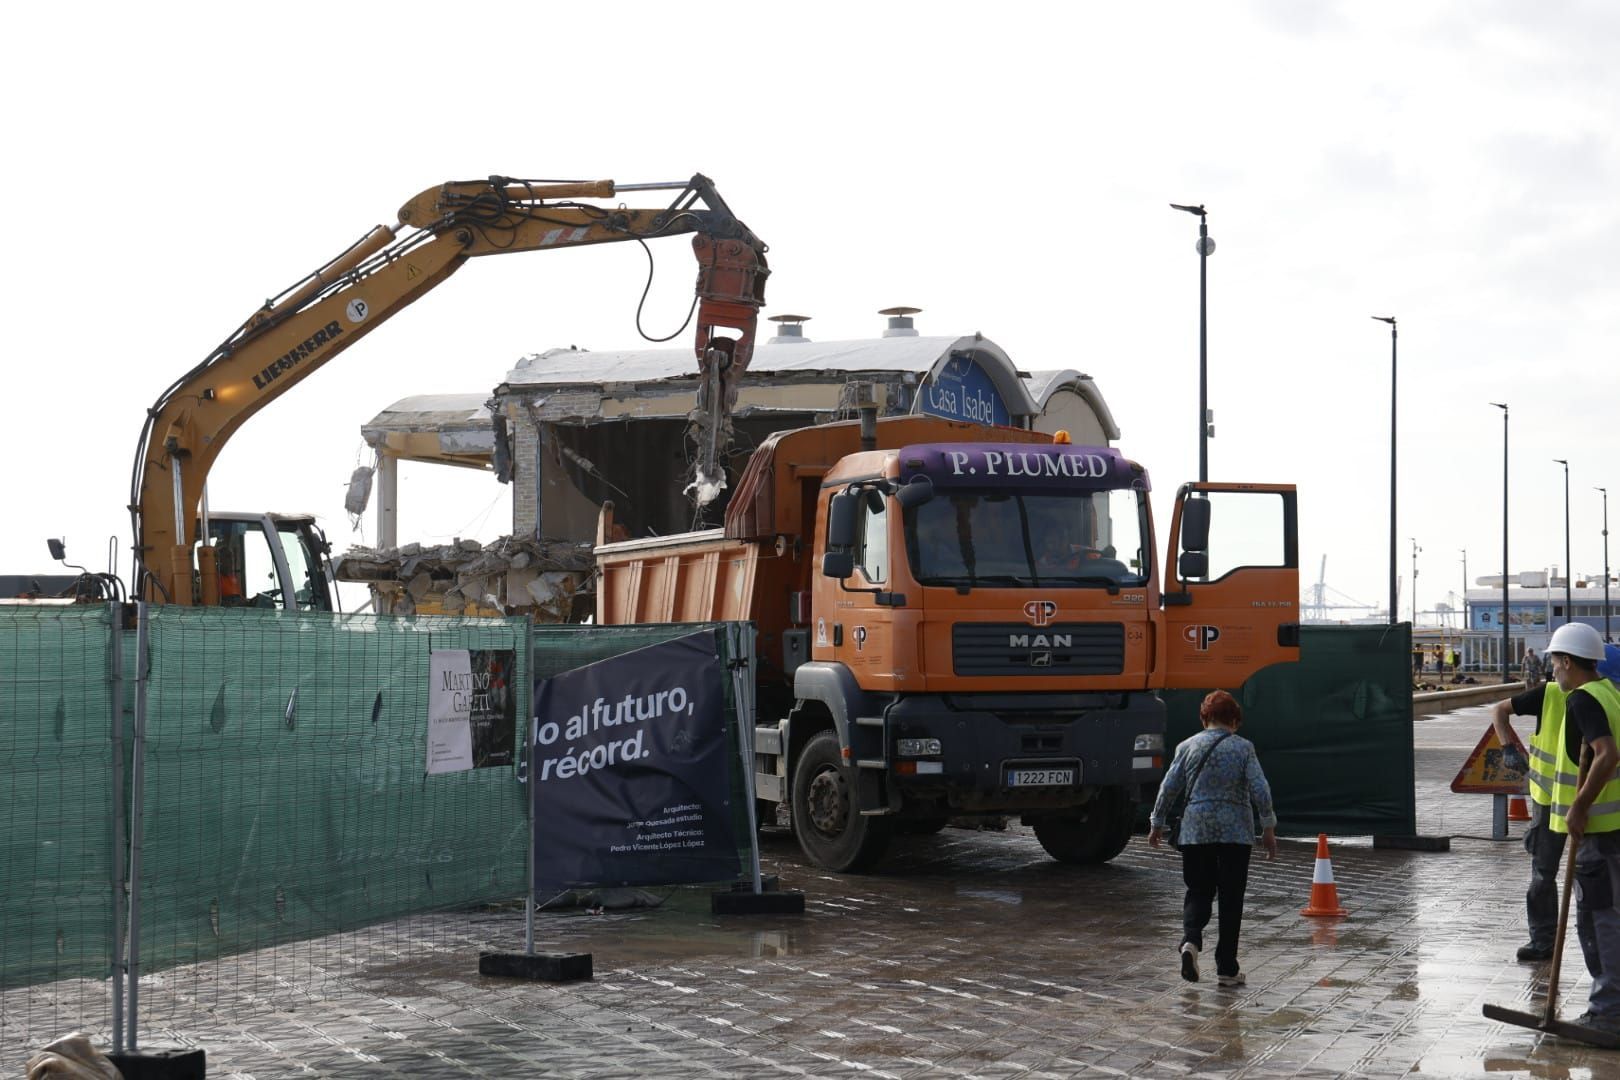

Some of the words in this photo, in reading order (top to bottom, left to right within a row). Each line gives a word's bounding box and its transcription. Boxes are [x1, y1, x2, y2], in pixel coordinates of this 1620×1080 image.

[252, 320, 344, 390] LIEBHERR
[929, 386, 957, 415] Casa
[961, 385, 995, 427] Isabel
[951, 451, 976, 475] P.
[984, 451, 1108, 478] PLUMED
[1009, 634, 1072, 648] MAN
[442, 670, 490, 692] MARTINO
[565, 704, 588, 741] al
[592, 687, 694, 731] futuro,
[540, 729, 650, 781] récord.
[1017, 772, 1045, 785] 1222
[1048, 771, 1071, 784] FCN
[645, 816, 676, 827] Quesada
[676, 813, 703, 823] estudio
[610, 844, 632, 852] Pedro
[632, 842, 659, 851] Vicente
[660, 840, 682, 850] López
[683, 839, 705, 848] López
[636, 831, 672, 841] Arquitecto
